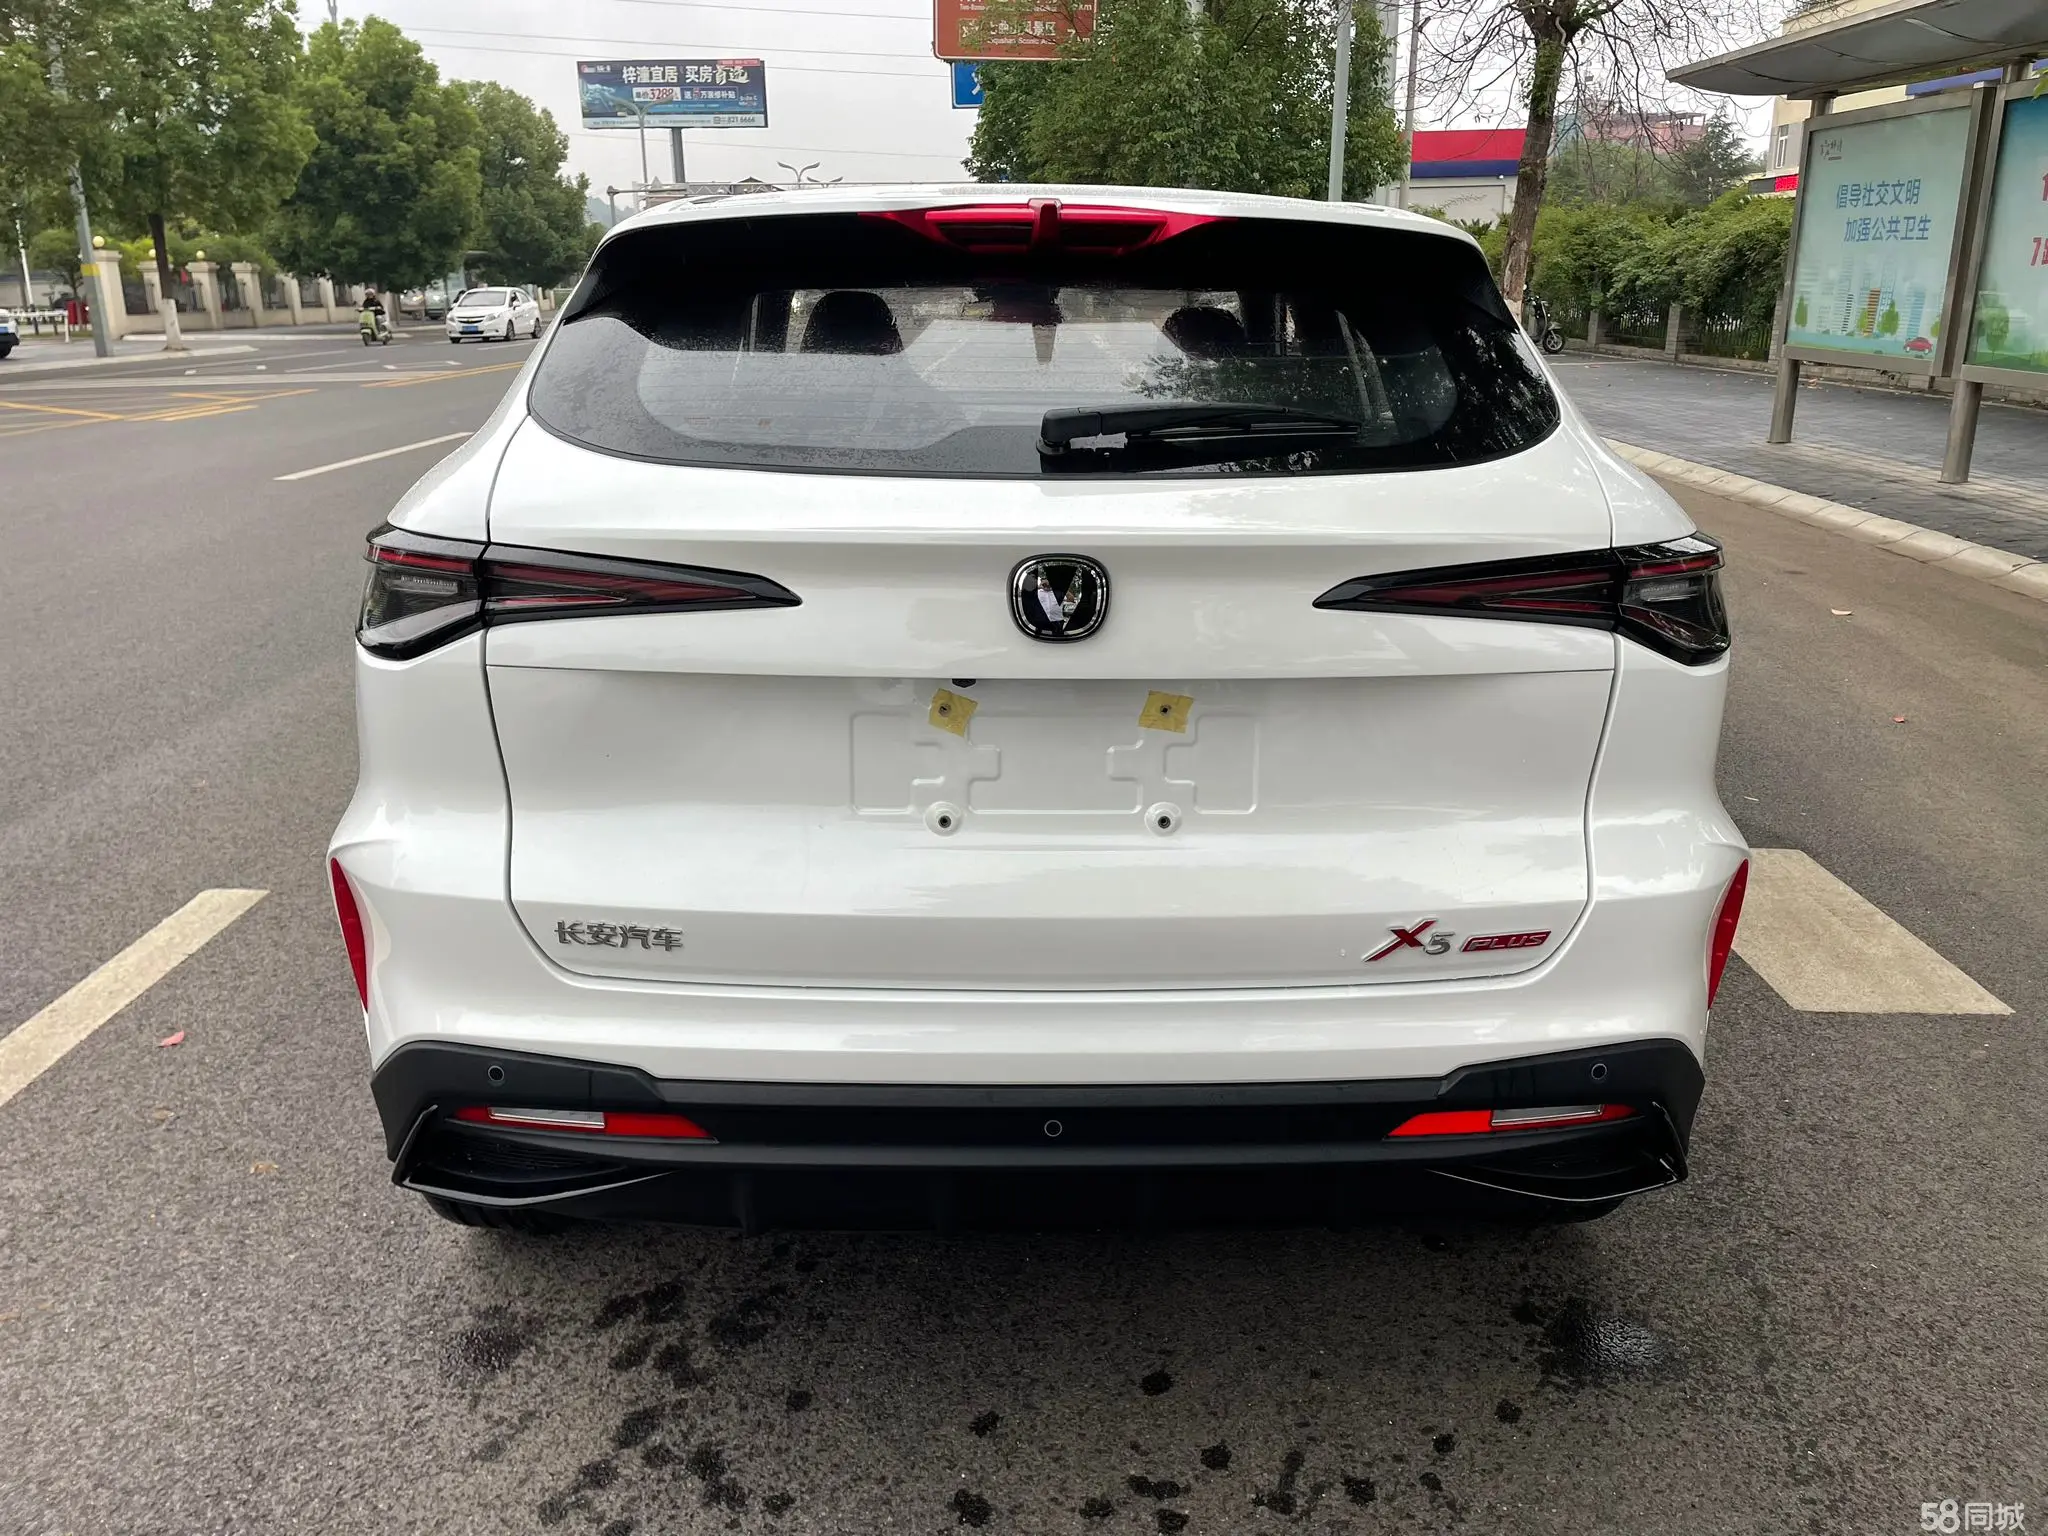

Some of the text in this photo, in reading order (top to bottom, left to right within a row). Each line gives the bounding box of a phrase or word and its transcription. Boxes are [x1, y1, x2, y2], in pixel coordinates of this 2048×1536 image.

[622, 65, 678, 84] 梓潼宜居
[685, 64, 749, 85] 买房首选
[1836, 178, 1921, 209] 倡导社交文明
[1844, 213, 1931, 243] 加强公共卫生
[554, 920, 683, 951] 长安汽车
[1462, 931, 1550, 952] PLUS
